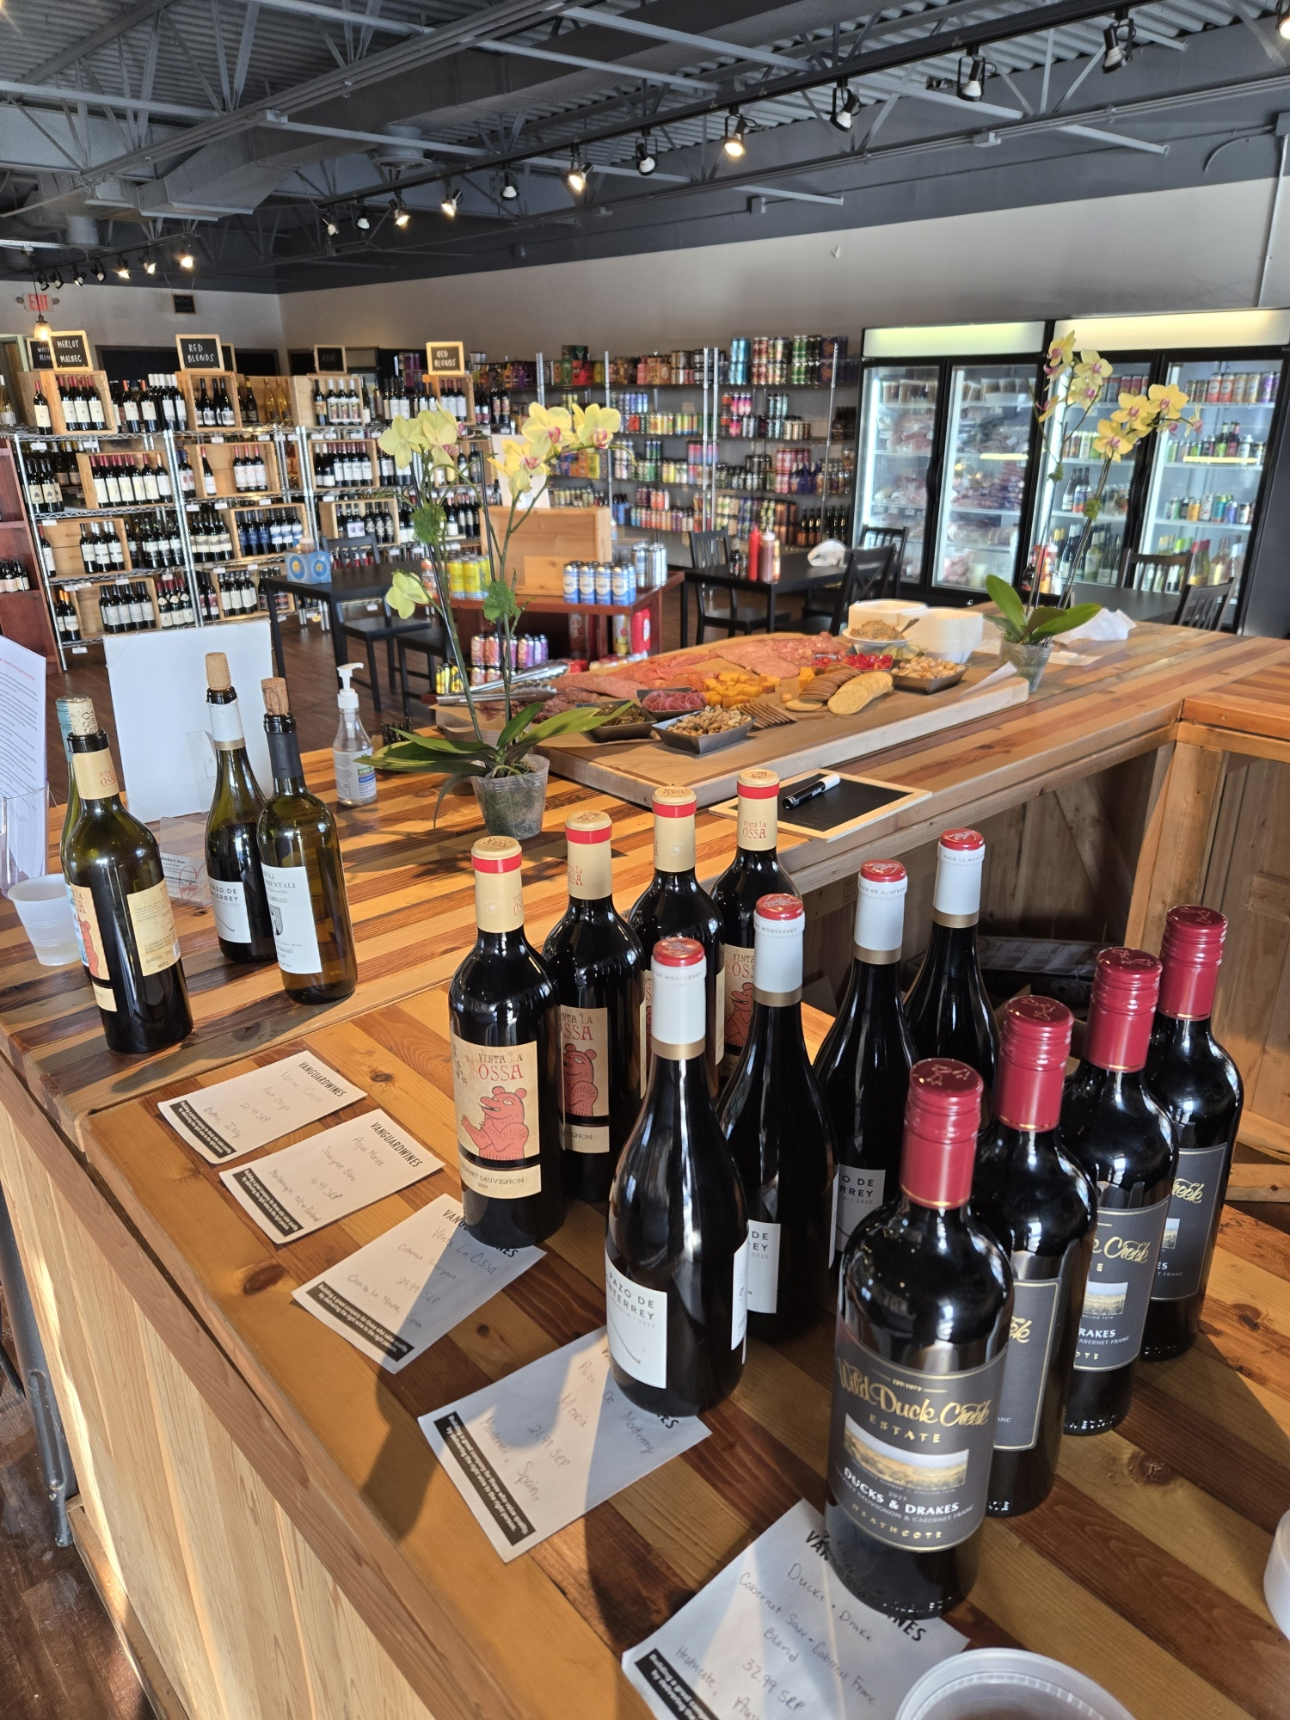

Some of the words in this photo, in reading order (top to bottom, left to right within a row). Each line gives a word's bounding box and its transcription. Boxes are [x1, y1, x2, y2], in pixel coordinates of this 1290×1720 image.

[57, 340, 79, 349] MERLOT
[188, 343, 203, 353] RED
[60, 354, 82, 363] MALBEC
[187, 354, 214, 363] BLENDS
[434, 359, 456, 368] BLENDS
[742, 828, 767, 839] OSSA
[563, 1024, 595, 1041] SSA
[478, 1053, 506, 1064] VENTA
[508, 1052, 523, 1062] LA
[478, 1063, 524, 1082] OSSA
[479, 1174, 525, 1185] SAUVIGNON
[857, 1178, 874, 1186] DE
[1172, 1178, 1205, 1204] reek
[752, 1231, 769, 1240] DE
[432, 1226, 454, 1248] Venta
[456, 1243, 468, 1257] La
[470, 1252, 497, 1275] Ossa
[1103, 1236, 1151, 1264] Creek
[421, 1290, 441, 1304] SRP
[610, 1271, 631, 1298] PAZO
[638, 1296, 654, 1309] DE
[1079, 1327, 1116, 1339] RAKES
[1079, 1338, 1109, 1346] ABERNET
[1110, 1335, 1130, 1345] FRANC
[578, 1361, 596, 1384] Pazo
[602, 1390, 615, 1405] De
[838, 1356, 872, 1403] Wild
[870, 1383, 939, 1423] Duck
[939, 1399, 992, 1427] Creek
[869, 1413, 942, 1444] ESTATE
[549, 1448, 571, 1468] SRP
[844, 1466, 885, 1504] DUCKS
[888, 1499, 901, 1510] &
[905, 1501, 960, 1516] DRAKES
[852, 1503, 943, 1539] HEATHCOTE
[912, 1515, 951, 1523] CABERNET
[953, 1503, 975, 1519] FRANC
[787, 1562, 826, 1602] Ducks
[838, 1610, 873, 1643] Drake
[738, 1571, 783, 1616] Cabernet
[785, 1613, 808, 1640] Sauv
[852, 1674, 876, 1707] Franc
[763, 1626, 800, 1664] Blend
[741, 1657, 777, 1694] 32.99
[777, 1690, 808, 1713] SRP
